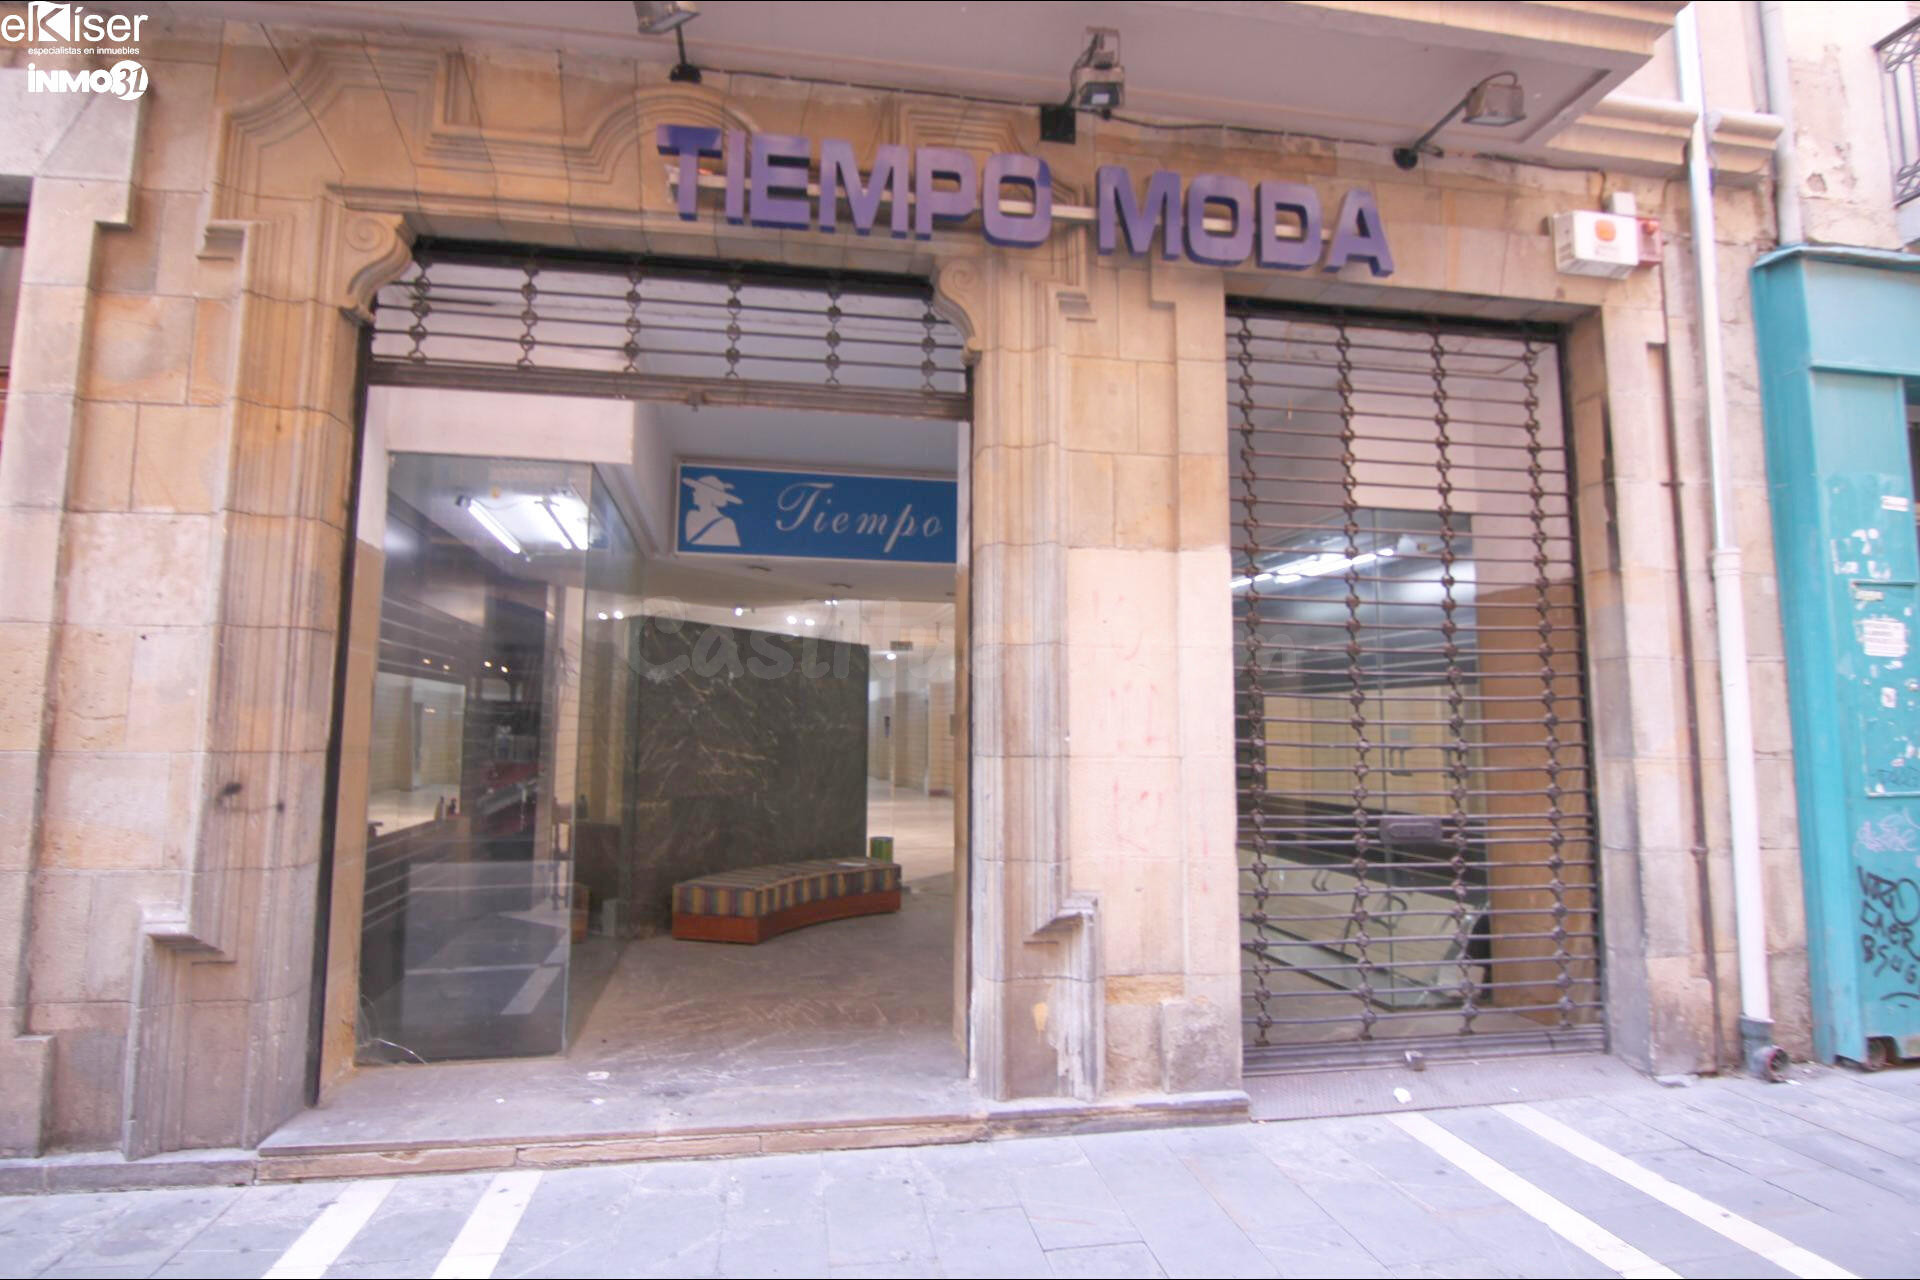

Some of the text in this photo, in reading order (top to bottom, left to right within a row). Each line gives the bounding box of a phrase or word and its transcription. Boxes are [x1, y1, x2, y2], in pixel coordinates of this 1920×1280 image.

[656, 124, 1394, 277] TIEMPO MODA
[775, 482, 943, 553] Tiempo
